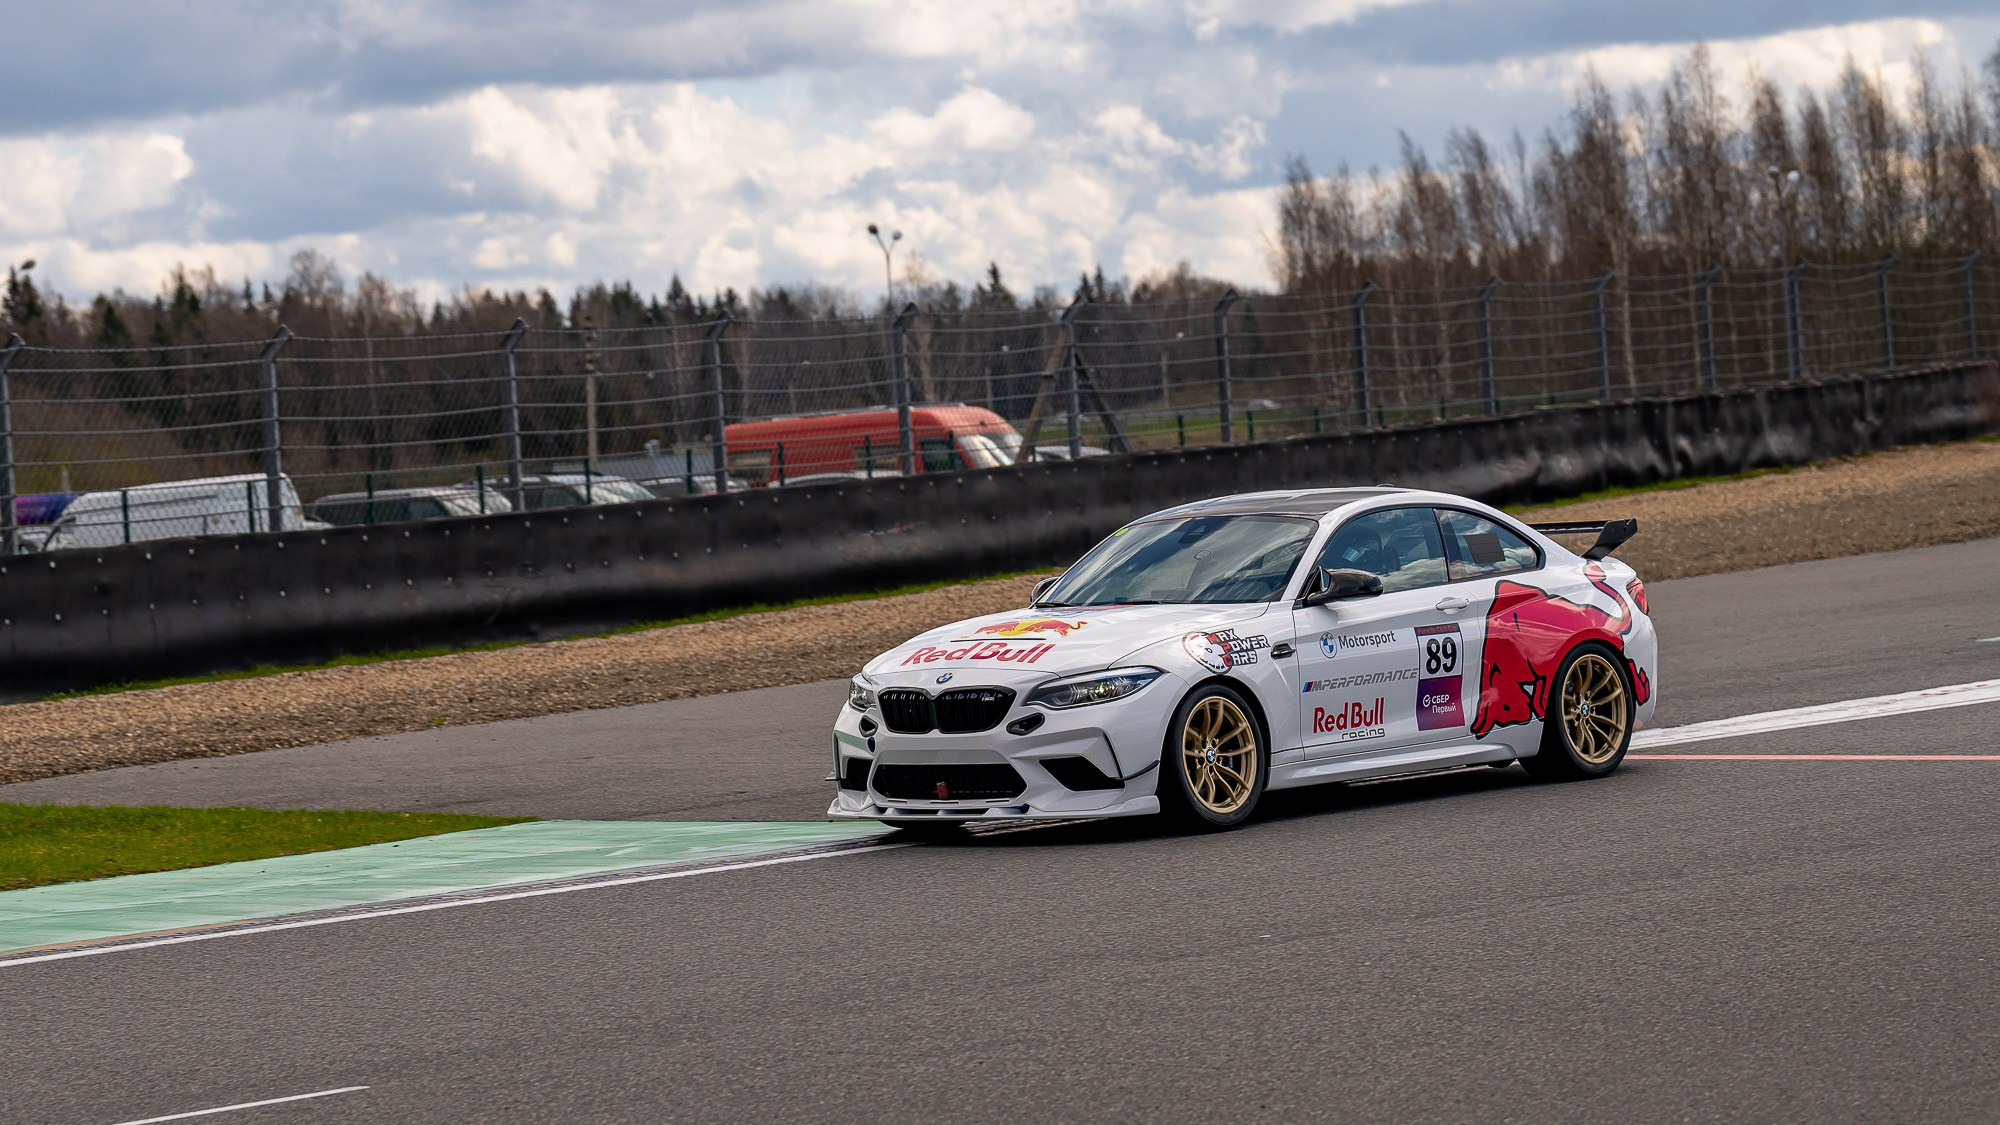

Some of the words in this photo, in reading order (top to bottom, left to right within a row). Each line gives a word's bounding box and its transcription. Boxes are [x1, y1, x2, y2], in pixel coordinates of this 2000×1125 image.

[1206, 629, 1238, 644] MAX
[1220, 635, 1268, 653] POWER
[1338, 630, 1397, 649] Motorsport
[900, 642, 984, 666] Red
[970, 642, 1056, 664] Bull
[1222, 650, 1257, 667] CARS
[1426, 636, 1457, 675] 89
[1432, 694, 1450, 704] СБЕР
[1313, 702, 1349, 734] Red
[1350, 697, 1385, 729] Bull
[1432, 702, 1457, 715] Первый
[1341, 727, 1386, 740] racing
